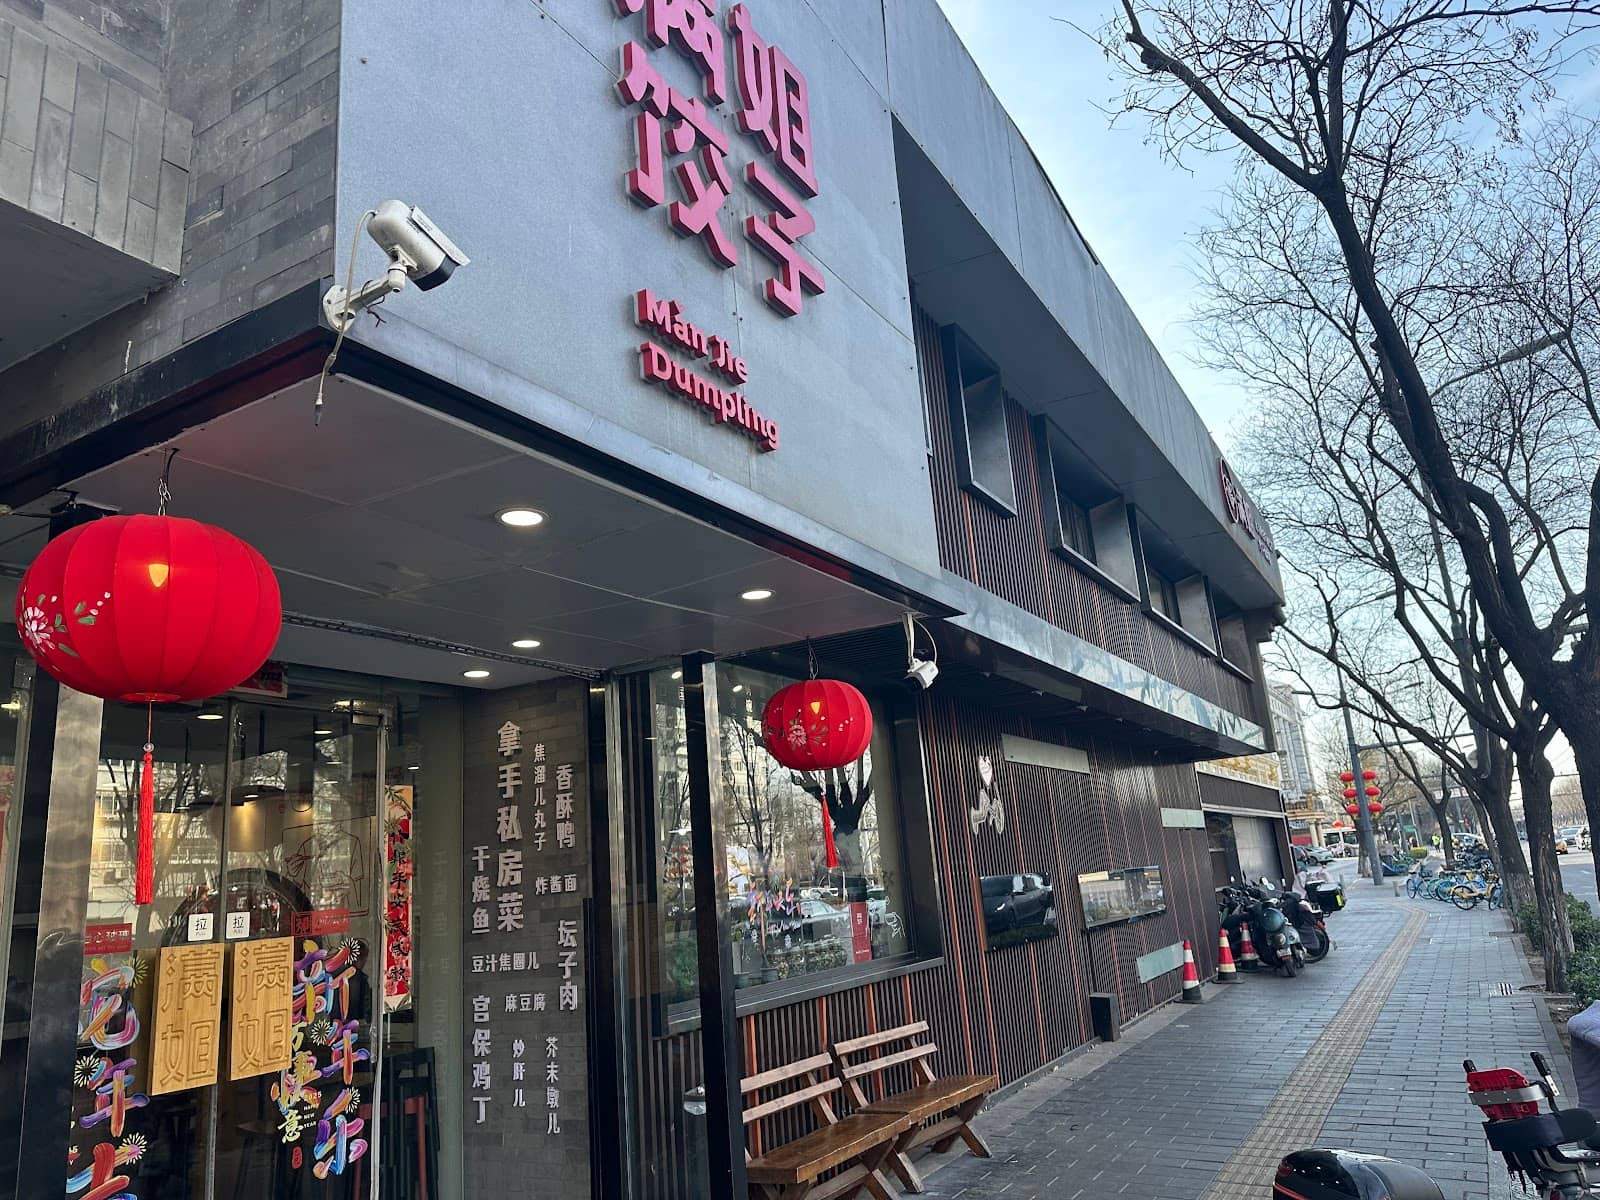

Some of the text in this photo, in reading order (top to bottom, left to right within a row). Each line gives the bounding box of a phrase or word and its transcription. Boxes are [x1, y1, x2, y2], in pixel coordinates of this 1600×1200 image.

[617, 41, 826, 319] 饺子
[640, 341, 781, 451] Dumpling
[497, 720, 524, 933] 拿手私房菜
[556, 764, 576, 849] 香酥鸭
[194, 918, 208, 931] 拉
[232, 915, 245, 929] 拉
[471, 845, 491, 935] 干烧鱼
[535, 873, 577, 896] 炸酱面
[237, 942, 290, 1072] 满姐
[471, 951, 541, 974] 豆汁焦圈儿
[505, 992, 547, 1013] 麻豆腐
[557, 919, 578, 1012] 坛子肉
[160, 949, 221, 1087] 满姐
[471, 994, 492, 1125] 宫保鸡丁
[512, 1039, 526, 1107] 炒肝儿
[545, 1036, 561, 1136] 芥末墩儿
